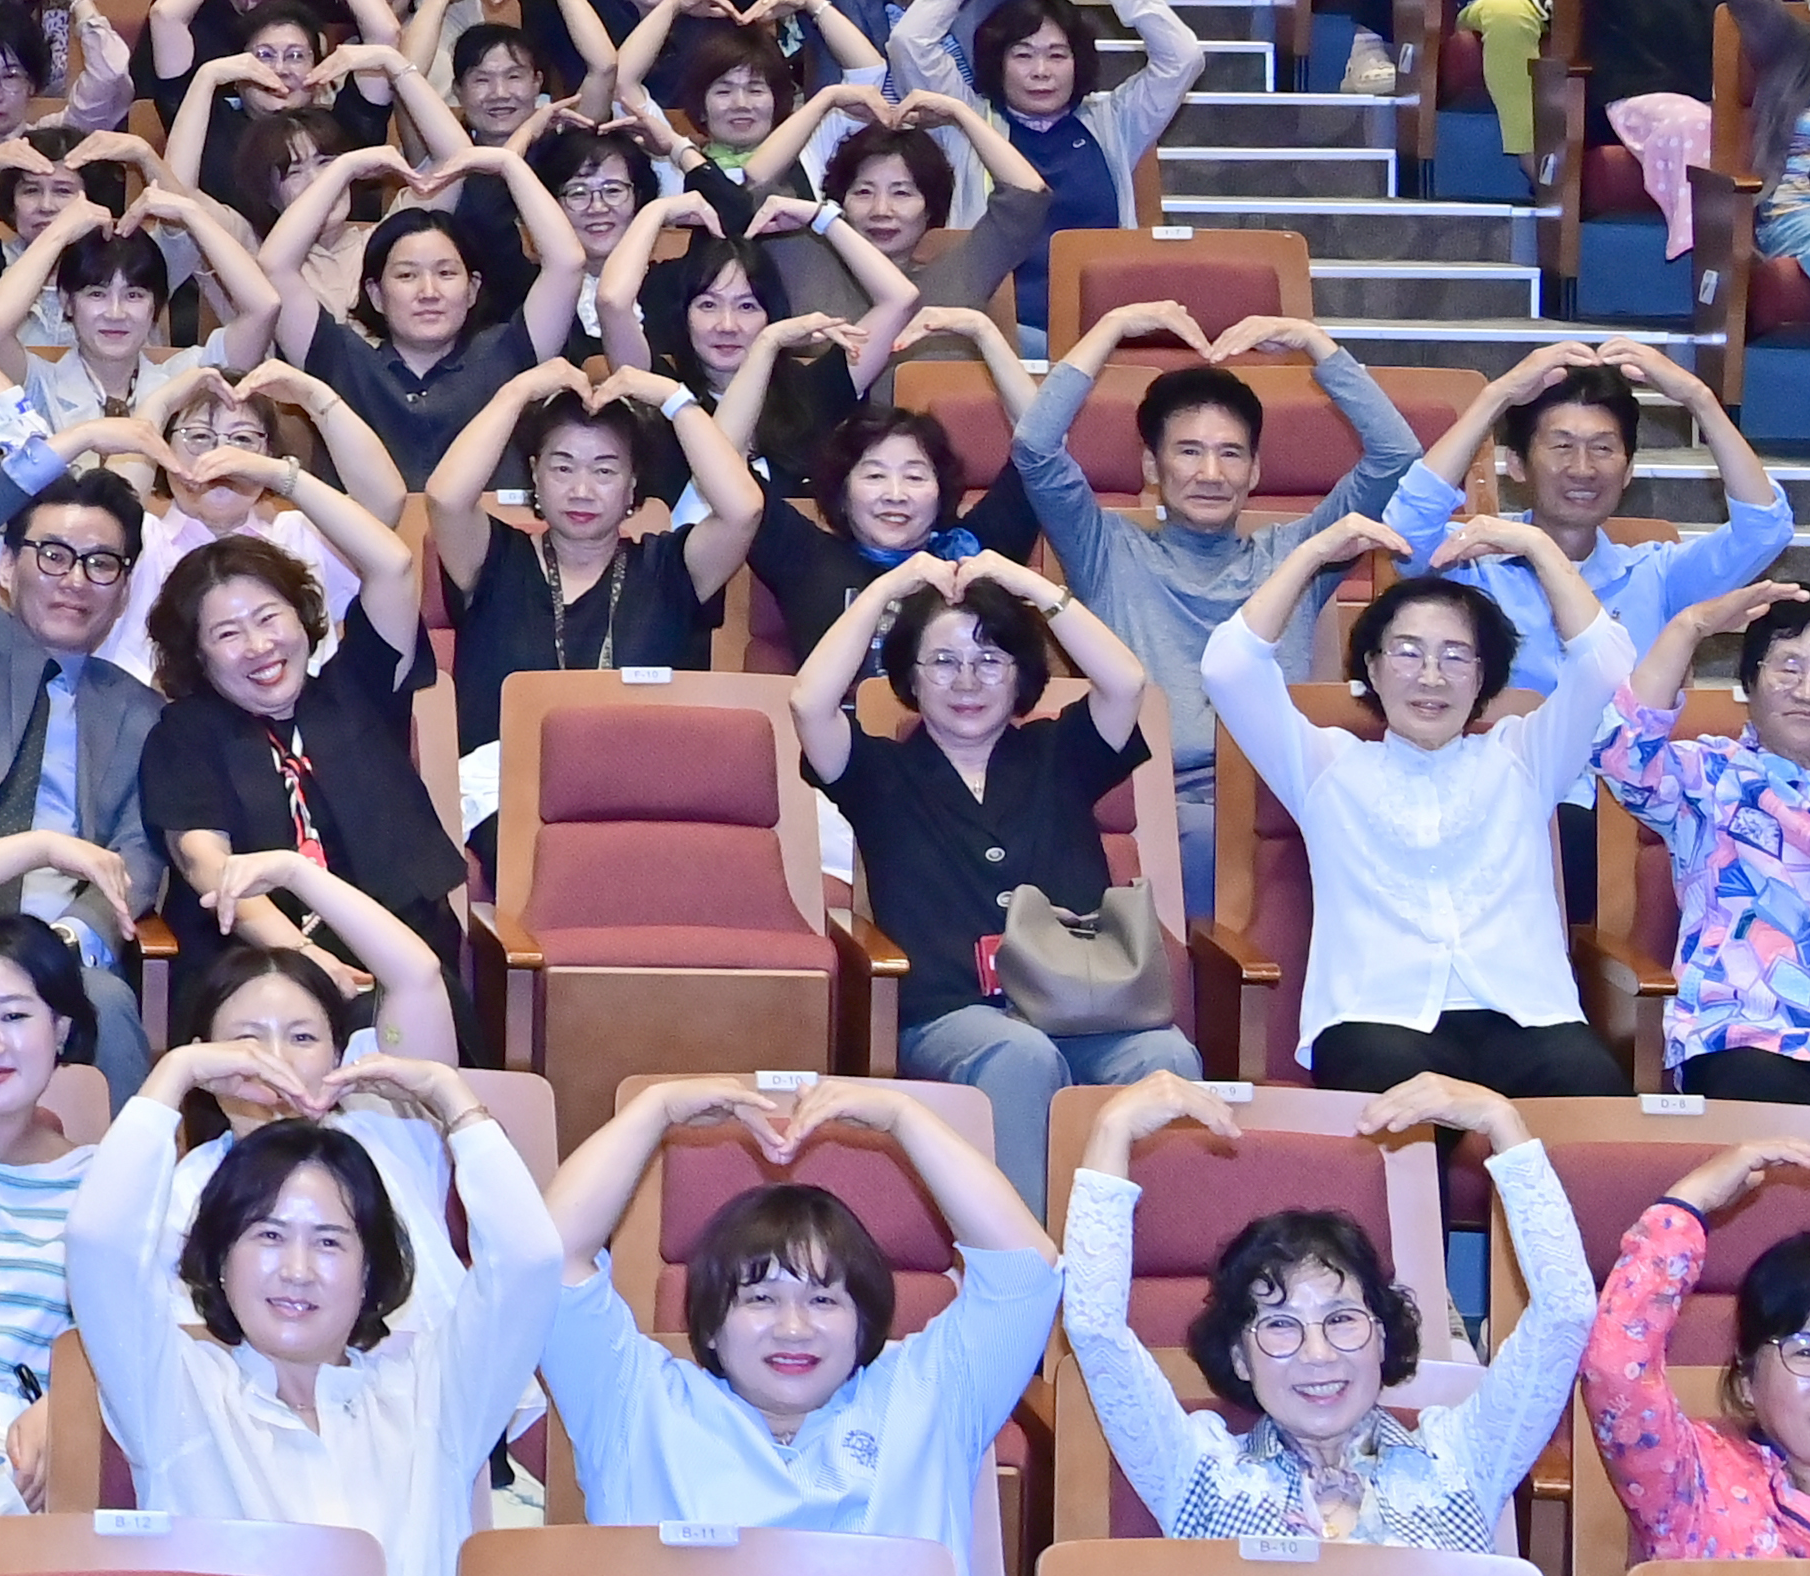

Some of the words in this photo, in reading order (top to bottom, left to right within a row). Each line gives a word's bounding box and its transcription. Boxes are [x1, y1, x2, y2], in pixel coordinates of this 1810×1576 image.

[115, 1515, 151, 1529] B-12
[682, 1526, 715, 1539] B-11
[1260, 1540, 1297, 1553] B-10
